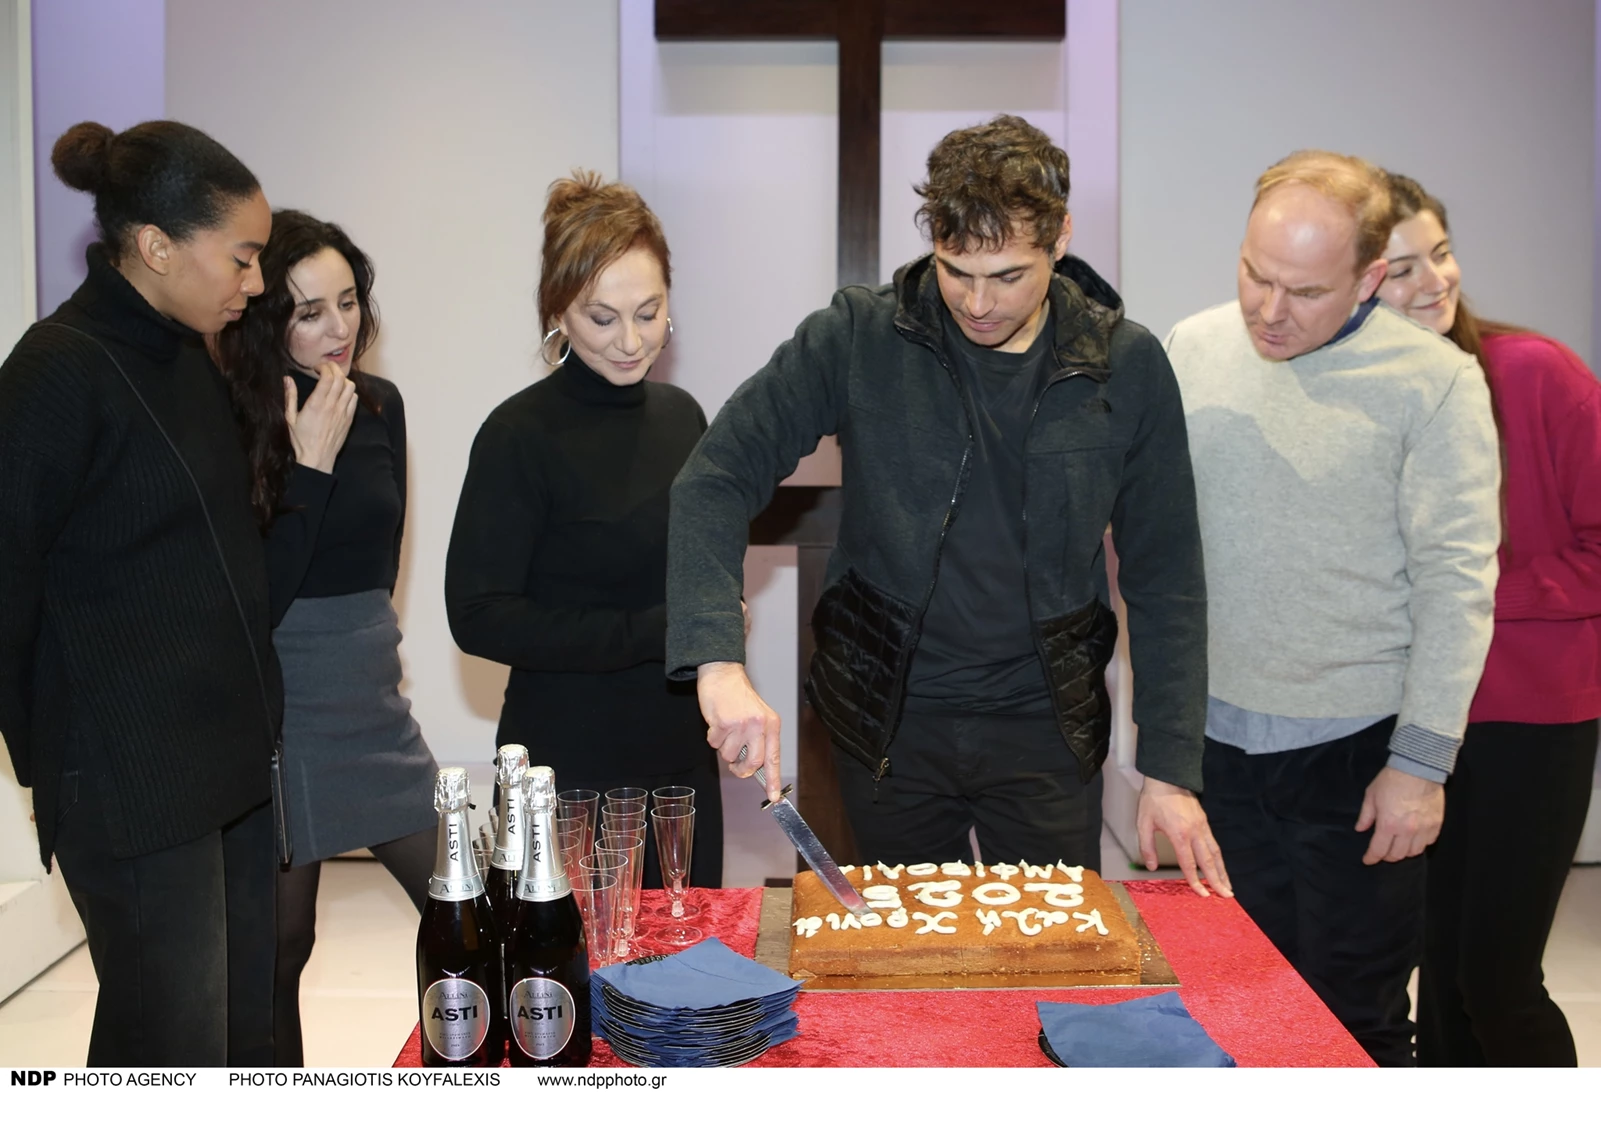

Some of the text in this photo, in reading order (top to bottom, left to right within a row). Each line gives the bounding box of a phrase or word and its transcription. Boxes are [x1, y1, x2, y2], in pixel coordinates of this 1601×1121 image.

[506, 798, 517, 835] ASTI
[448, 823, 459, 862] ASTI
[532, 824, 542, 863] ASTI
[862, 880, 1084, 908] 2025
[431, 1005, 478, 1021] ASTI
[517, 1005, 563, 1020] ASTI
